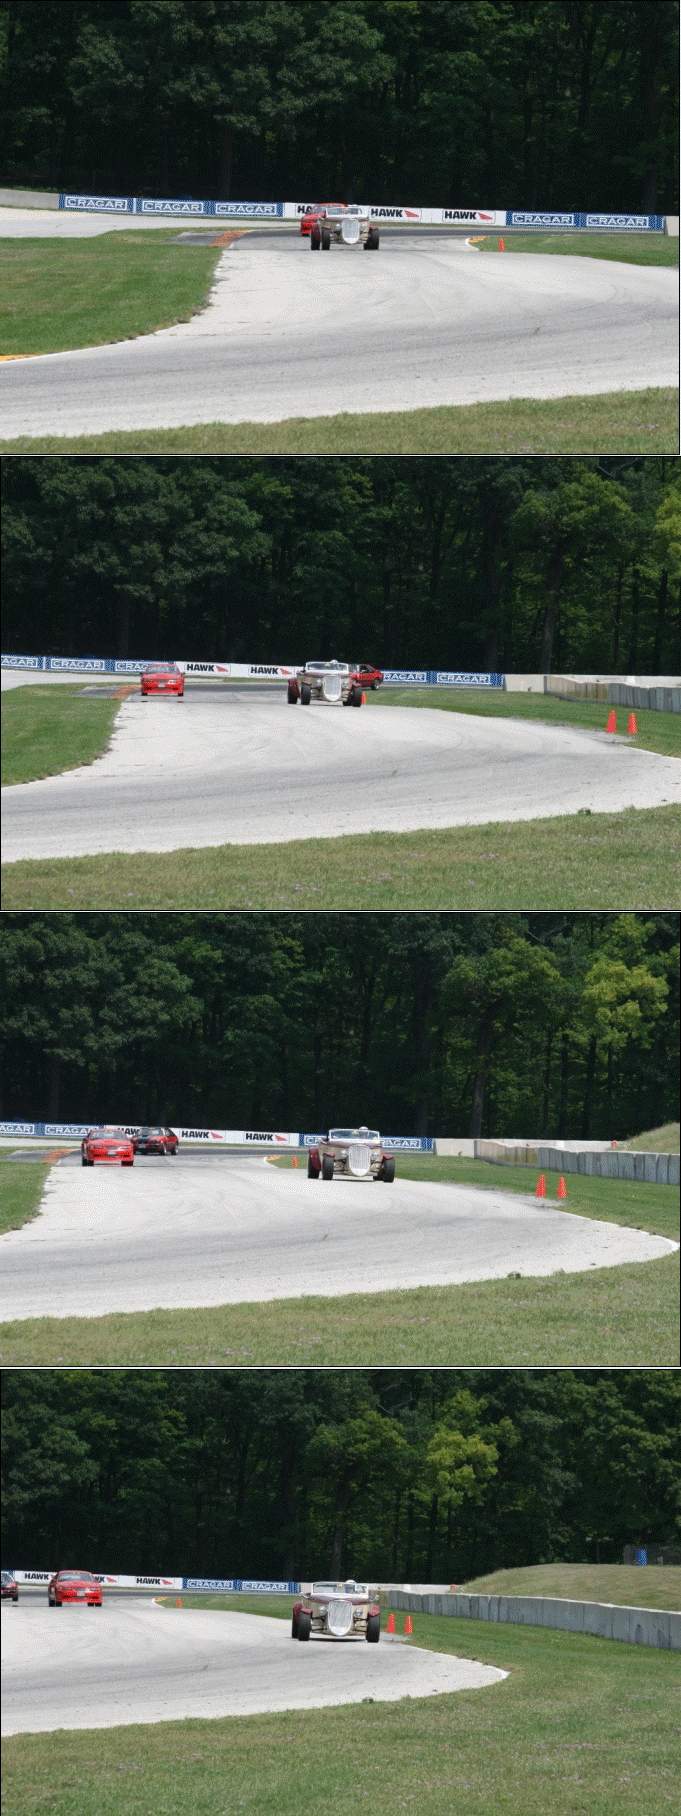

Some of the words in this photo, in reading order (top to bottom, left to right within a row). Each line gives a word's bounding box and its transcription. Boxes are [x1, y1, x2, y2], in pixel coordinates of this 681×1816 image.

[67, 198, 123, 208] CRAGAR
[144, 202, 200, 212] CRAGAR
[217, 204, 273, 213] CRAGAR
[297, 205, 312, 214] HA
[371, 208, 403, 218] HAWK
[444, 210, 477, 219] HAWK
[514, 214, 571, 224] CRAGAR
[589, 217, 646, 226] CRAGAR
[1, 658, 35, 667] AGAR
[53, 660, 102, 669] CRAGAR
[186, 663, 215, 672] HAWK
[250, 666, 279, 675] HAWK
[383, 672, 423, 681] RAGAR
[440, 674, 487, 683] CRAGAR
[0, 1124, 31, 1133] AGAR
[181, 1130, 209, 1139] HAWK
[245, 1132, 274, 1141] HAWK
[24, 1572, 49, 1580] HAWK
[136, 1577, 161, 1585] HAWK
